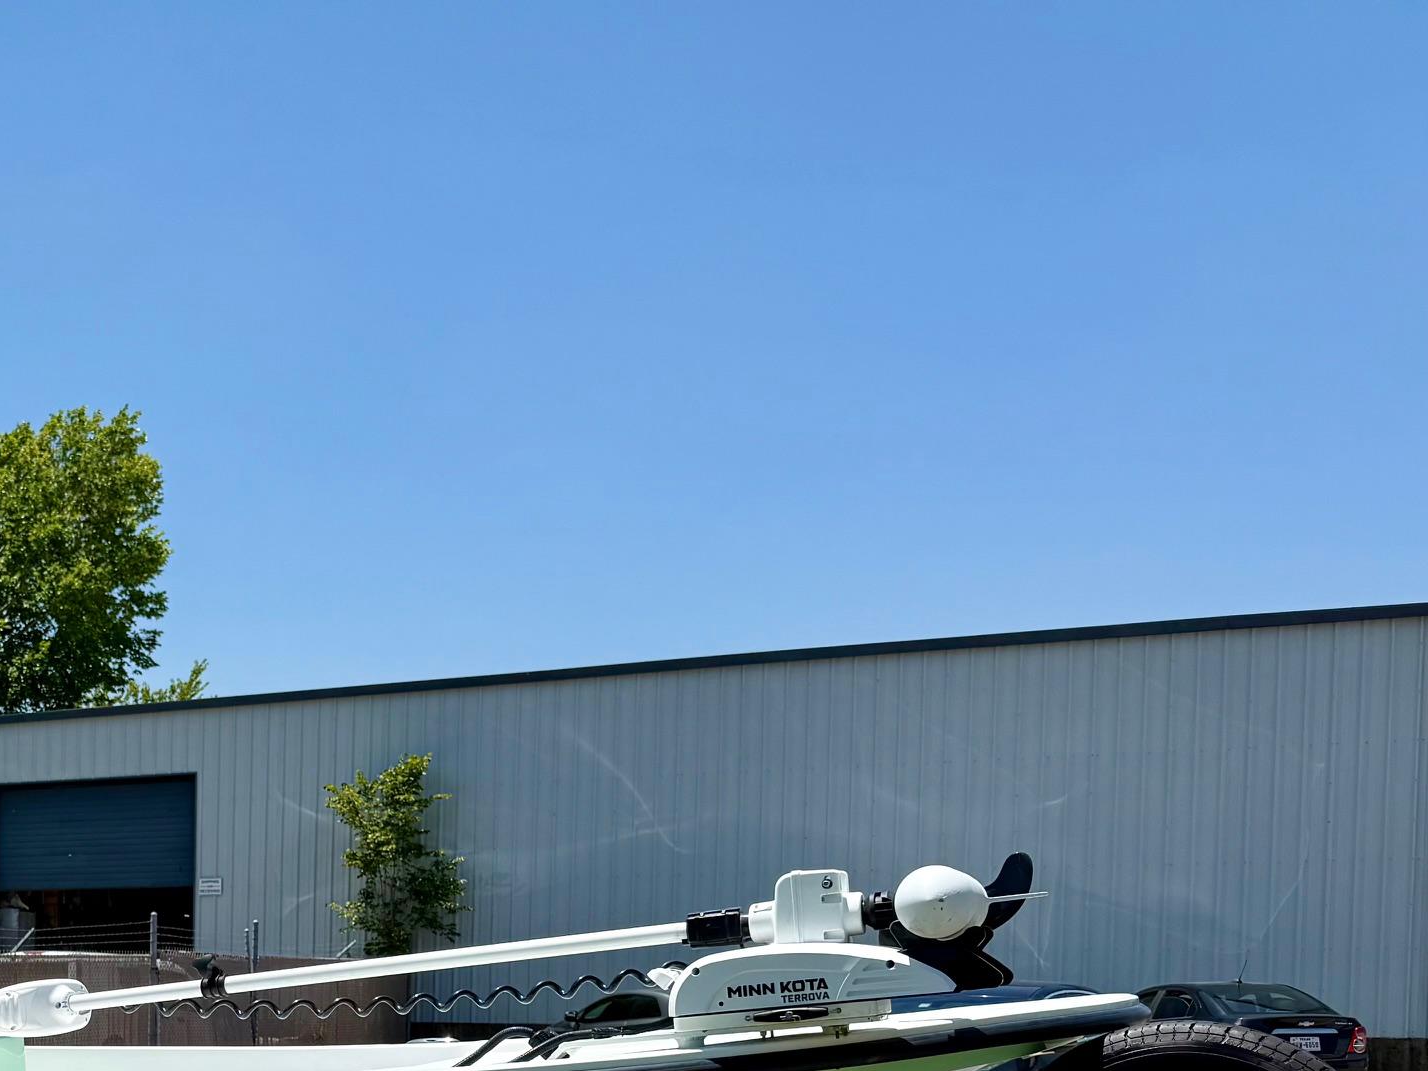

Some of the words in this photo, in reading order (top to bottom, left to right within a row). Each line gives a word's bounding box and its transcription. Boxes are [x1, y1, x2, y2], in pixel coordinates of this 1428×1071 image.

[727, 982, 775, 998] MINN
[780, 978, 829, 993] KOTA
[780, 992, 830, 1004] TERROVA
